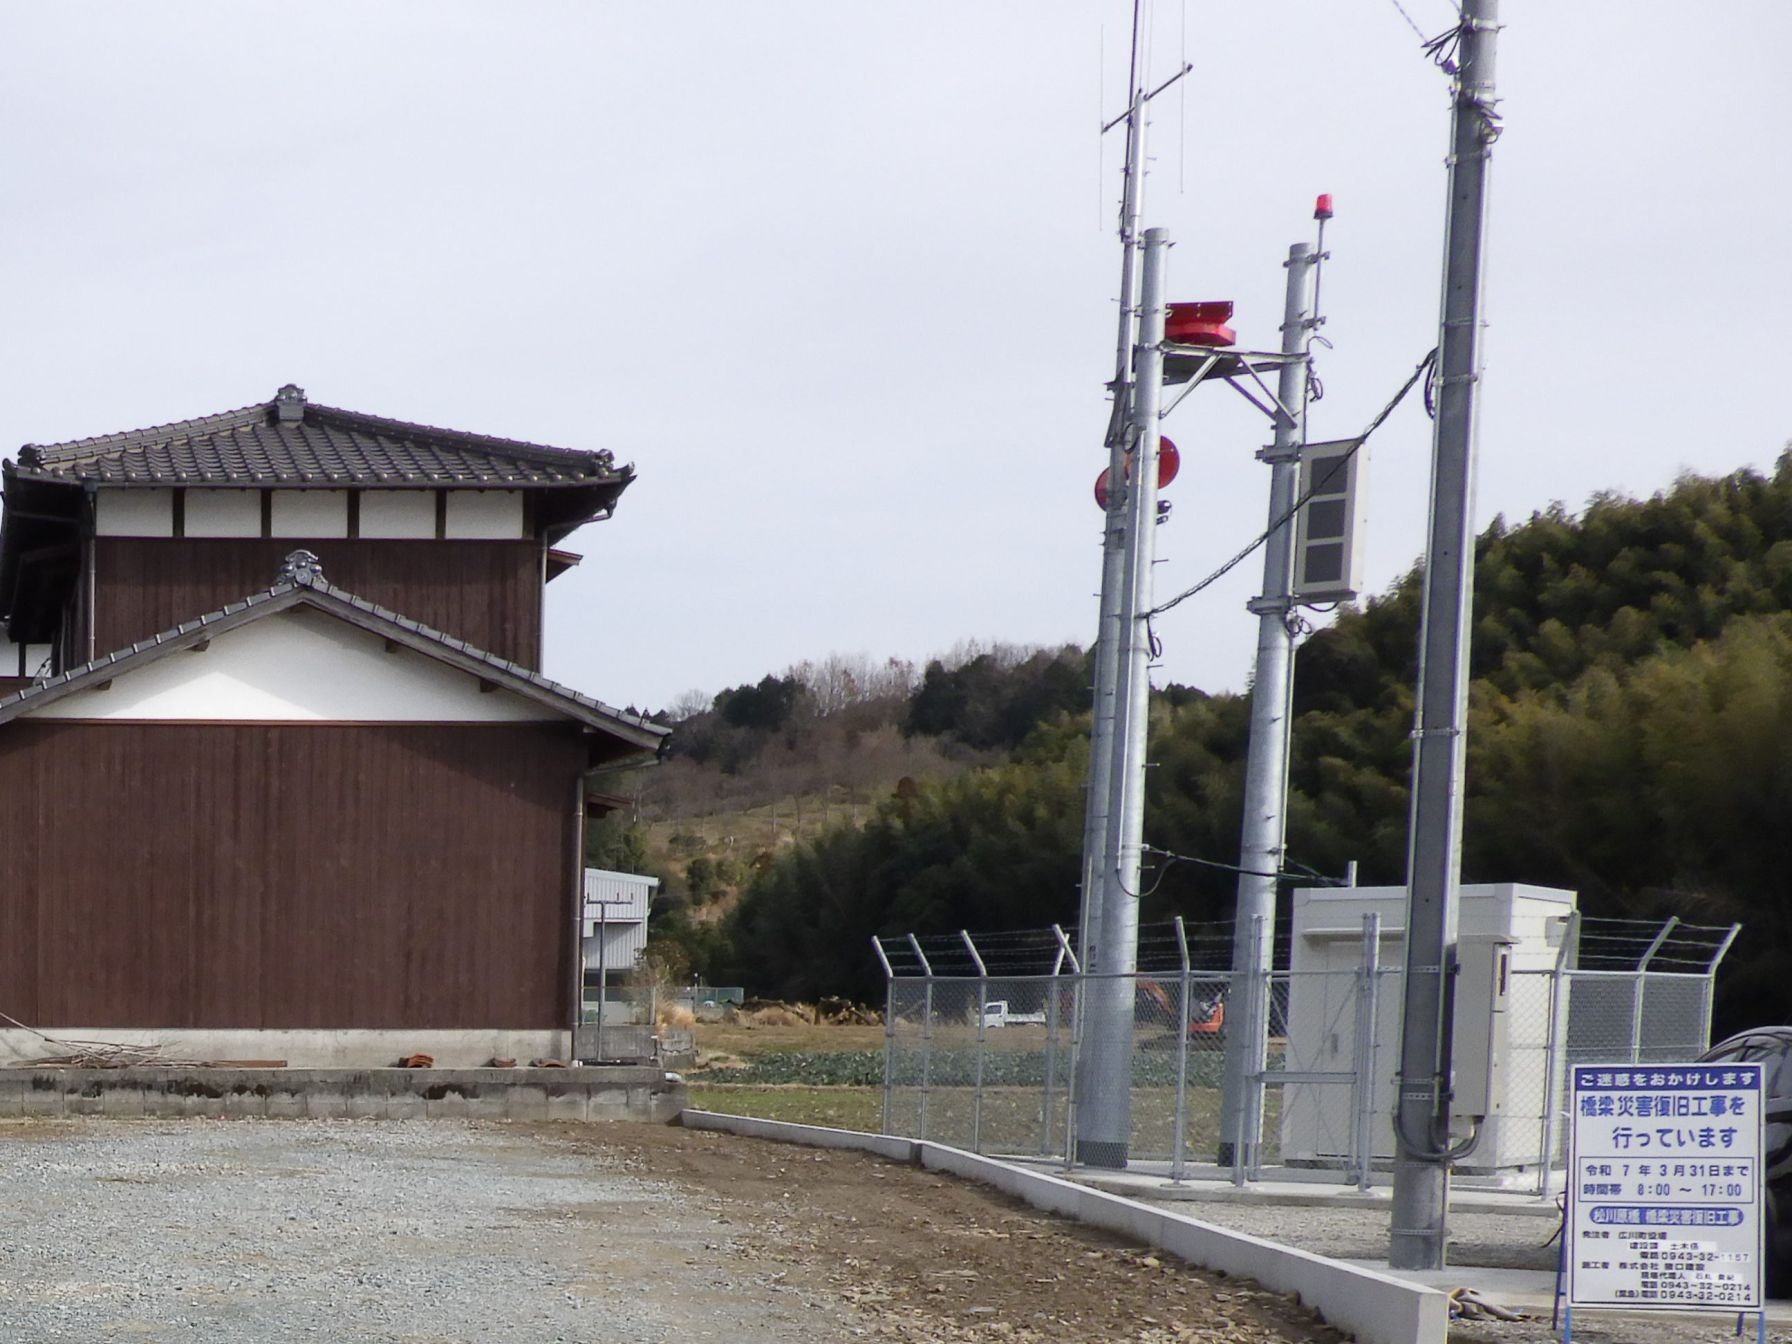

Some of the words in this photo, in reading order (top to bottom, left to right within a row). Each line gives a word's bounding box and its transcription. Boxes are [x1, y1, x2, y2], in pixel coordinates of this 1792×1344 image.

[1580, 1072, 1755, 1087] ご迷惑をおかけします
[1580, 1095, 1746, 1118] 橋梁災害復旧工事を
[1612, 1127, 1738, 1149] 行っています
[1583, 1183, 1622, 1196] 時間帯
[1637, 1183, 1670, 1196] 8:00
[1701, 1184, 1742, 1197] 17:00
